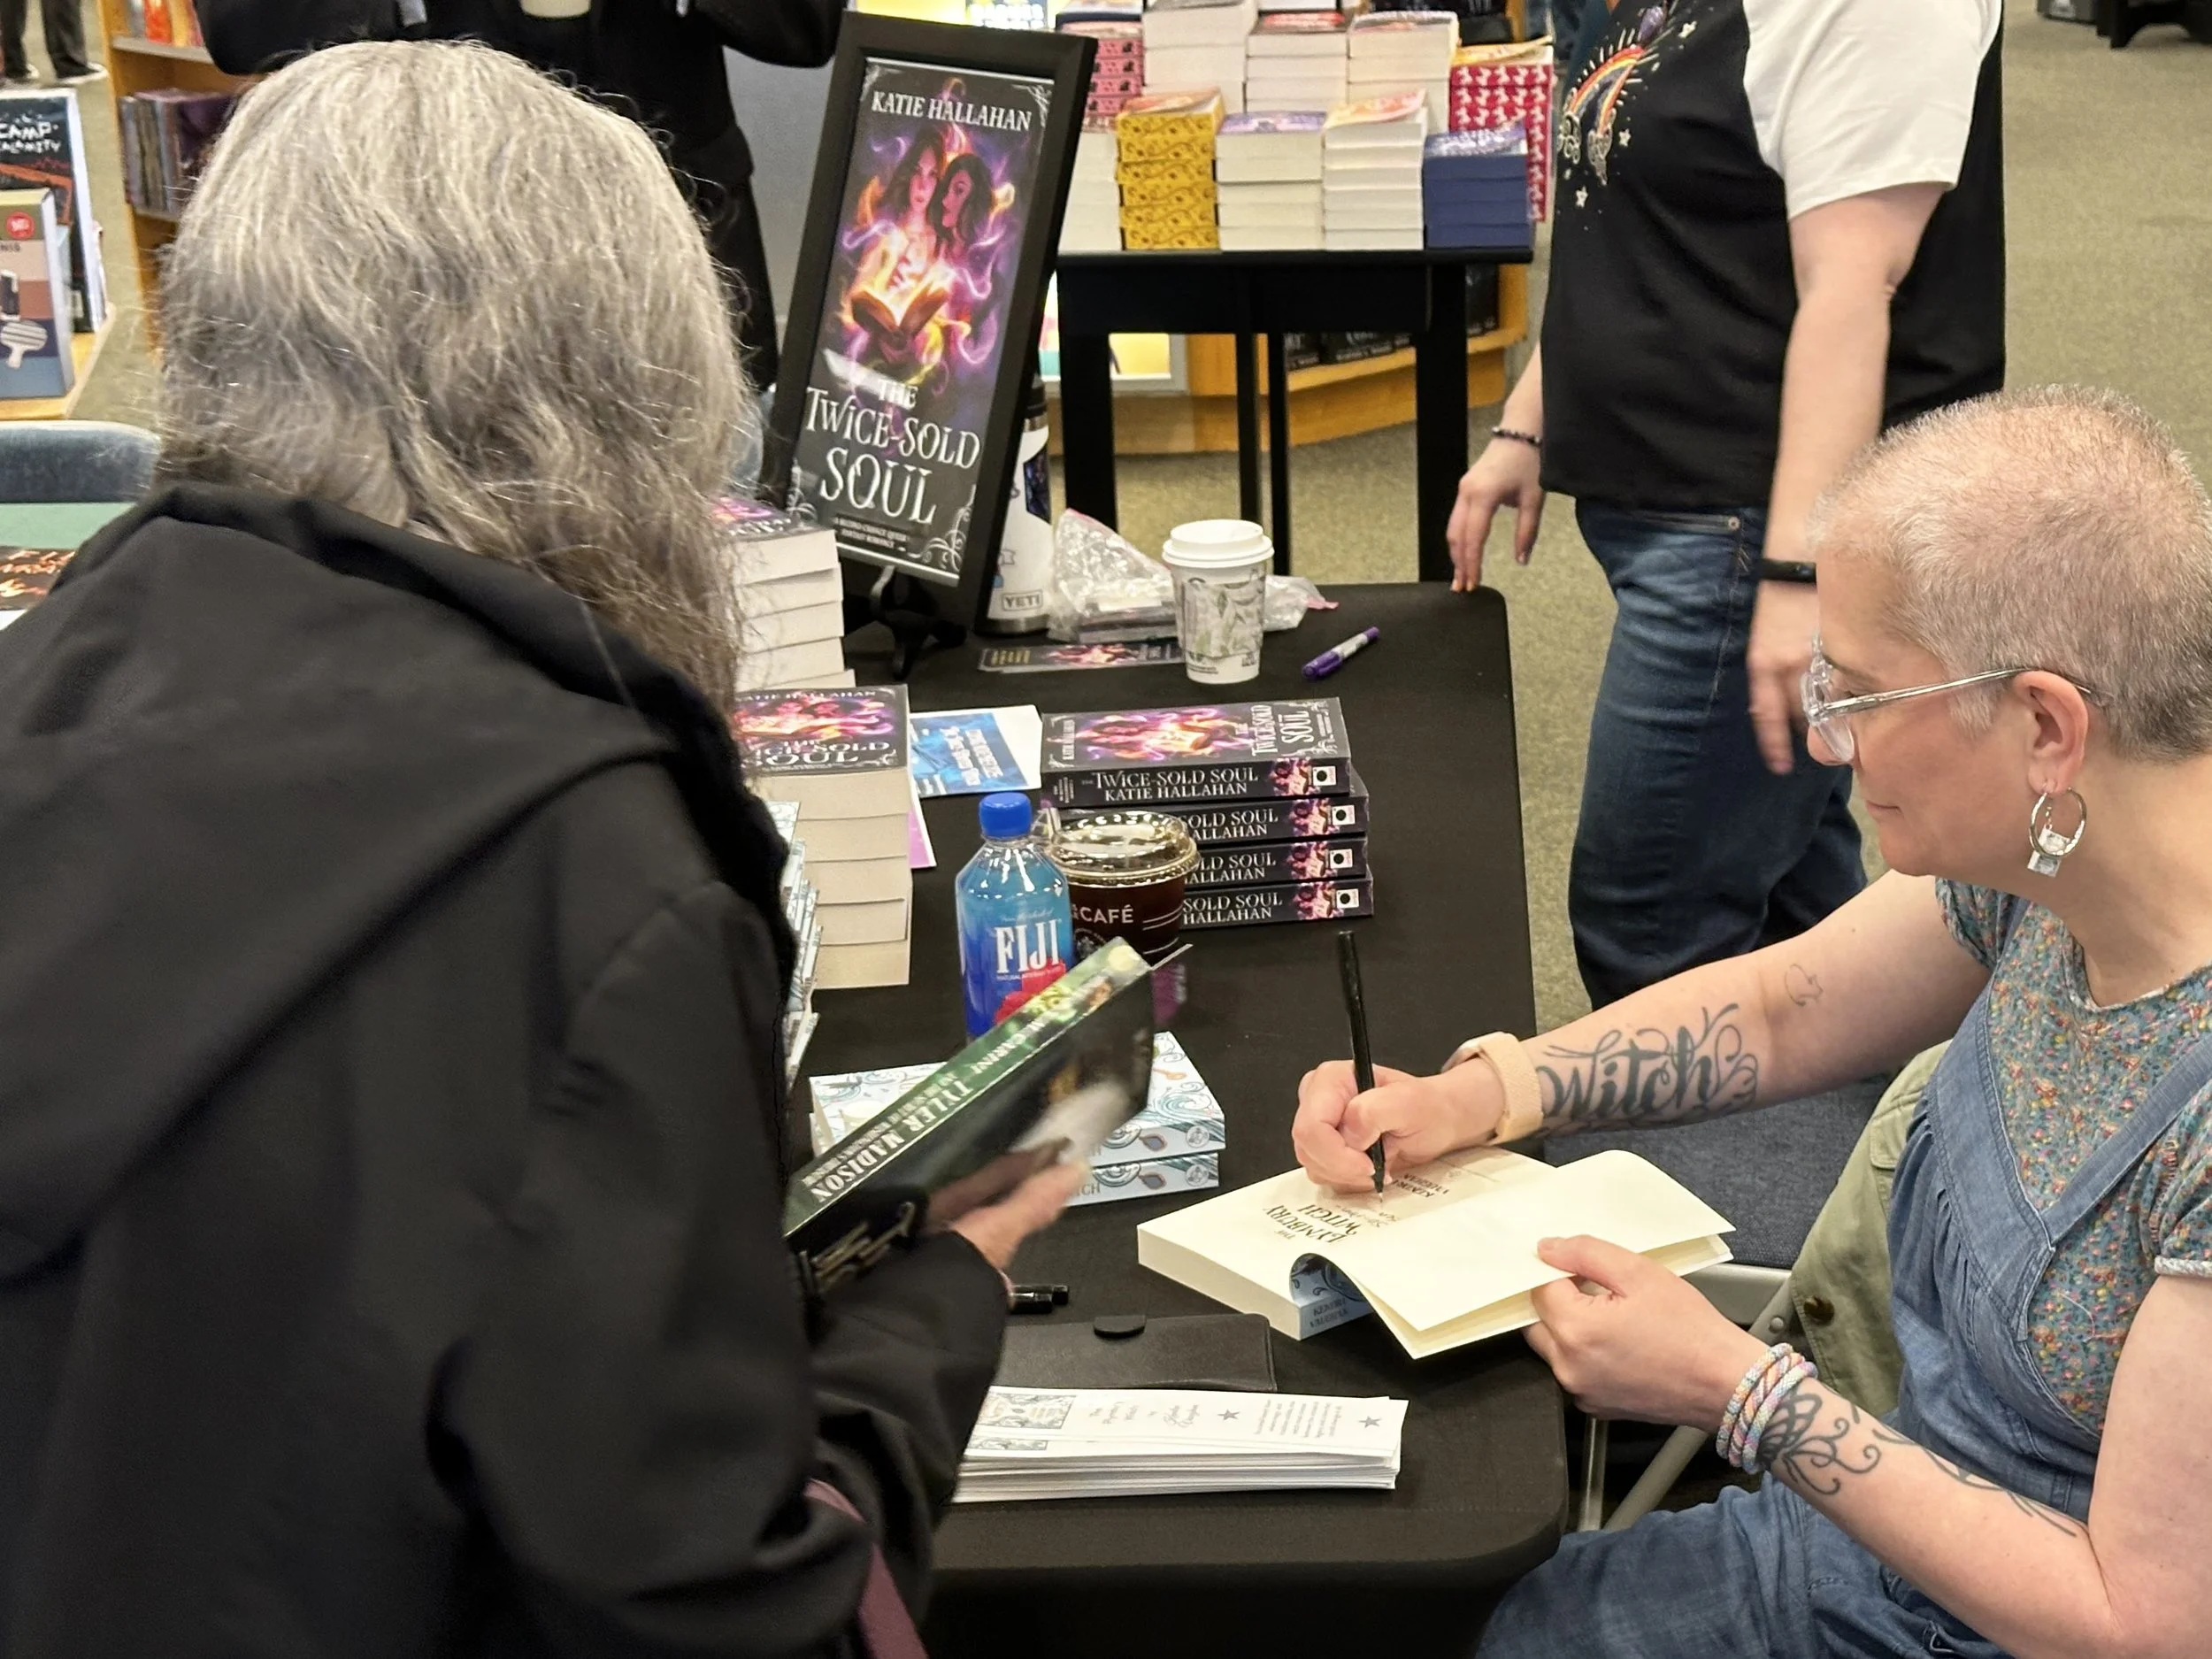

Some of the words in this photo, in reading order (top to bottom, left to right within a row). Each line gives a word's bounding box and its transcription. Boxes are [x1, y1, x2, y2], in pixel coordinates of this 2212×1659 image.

[872, 90, 926, 118] KATIE
[927, 98, 1033, 132] HALLAHAN
[0, 139, 61, 154] ALAMITY
[878, 379, 919, 410] THE
[819, 447, 937, 525] SOUL
[1004, 594, 1041, 609] YETI
[1278, 710, 1315, 744] SOUL
[1210, 766, 1259, 783] SOUL
[1105, 787, 1154, 803] KATIE
[1157, 782, 1248, 799] HALLAHAN
[1231, 808, 1279, 826] SOUL
[1192, 824, 1268, 841] ALLAHAN
[1228, 852, 1277, 869] SOUL
[1235, 892, 1283, 909] SOUL
[1079, 903, 1134, 925] CAFÉ
[1182, 907, 1272, 926] HALLAHAN
[995, 919, 1060, 974] FIJI
[902, 1080, 973, 1133] TYLER
[810, 1128, 906, 1203] MADISON
[1296, 1203, 1363, 1236] WITCH
